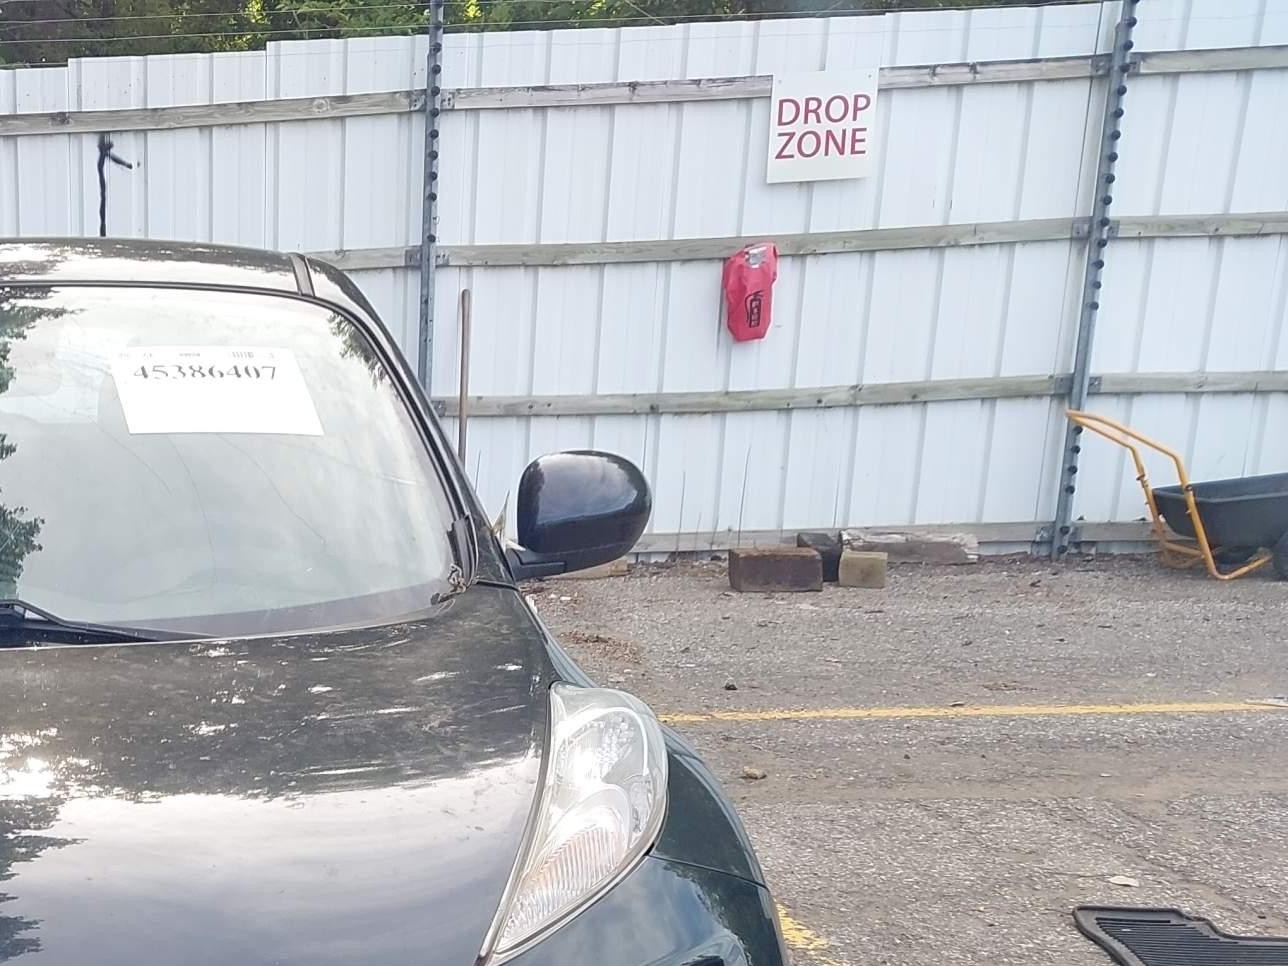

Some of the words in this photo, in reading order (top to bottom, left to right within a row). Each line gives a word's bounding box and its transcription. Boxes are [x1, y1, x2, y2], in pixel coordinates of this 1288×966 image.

[777, 94, 871, 126] DROP
[775, 127, 867, 159] ZONE
[133, 365, 276, 379] 45386407
